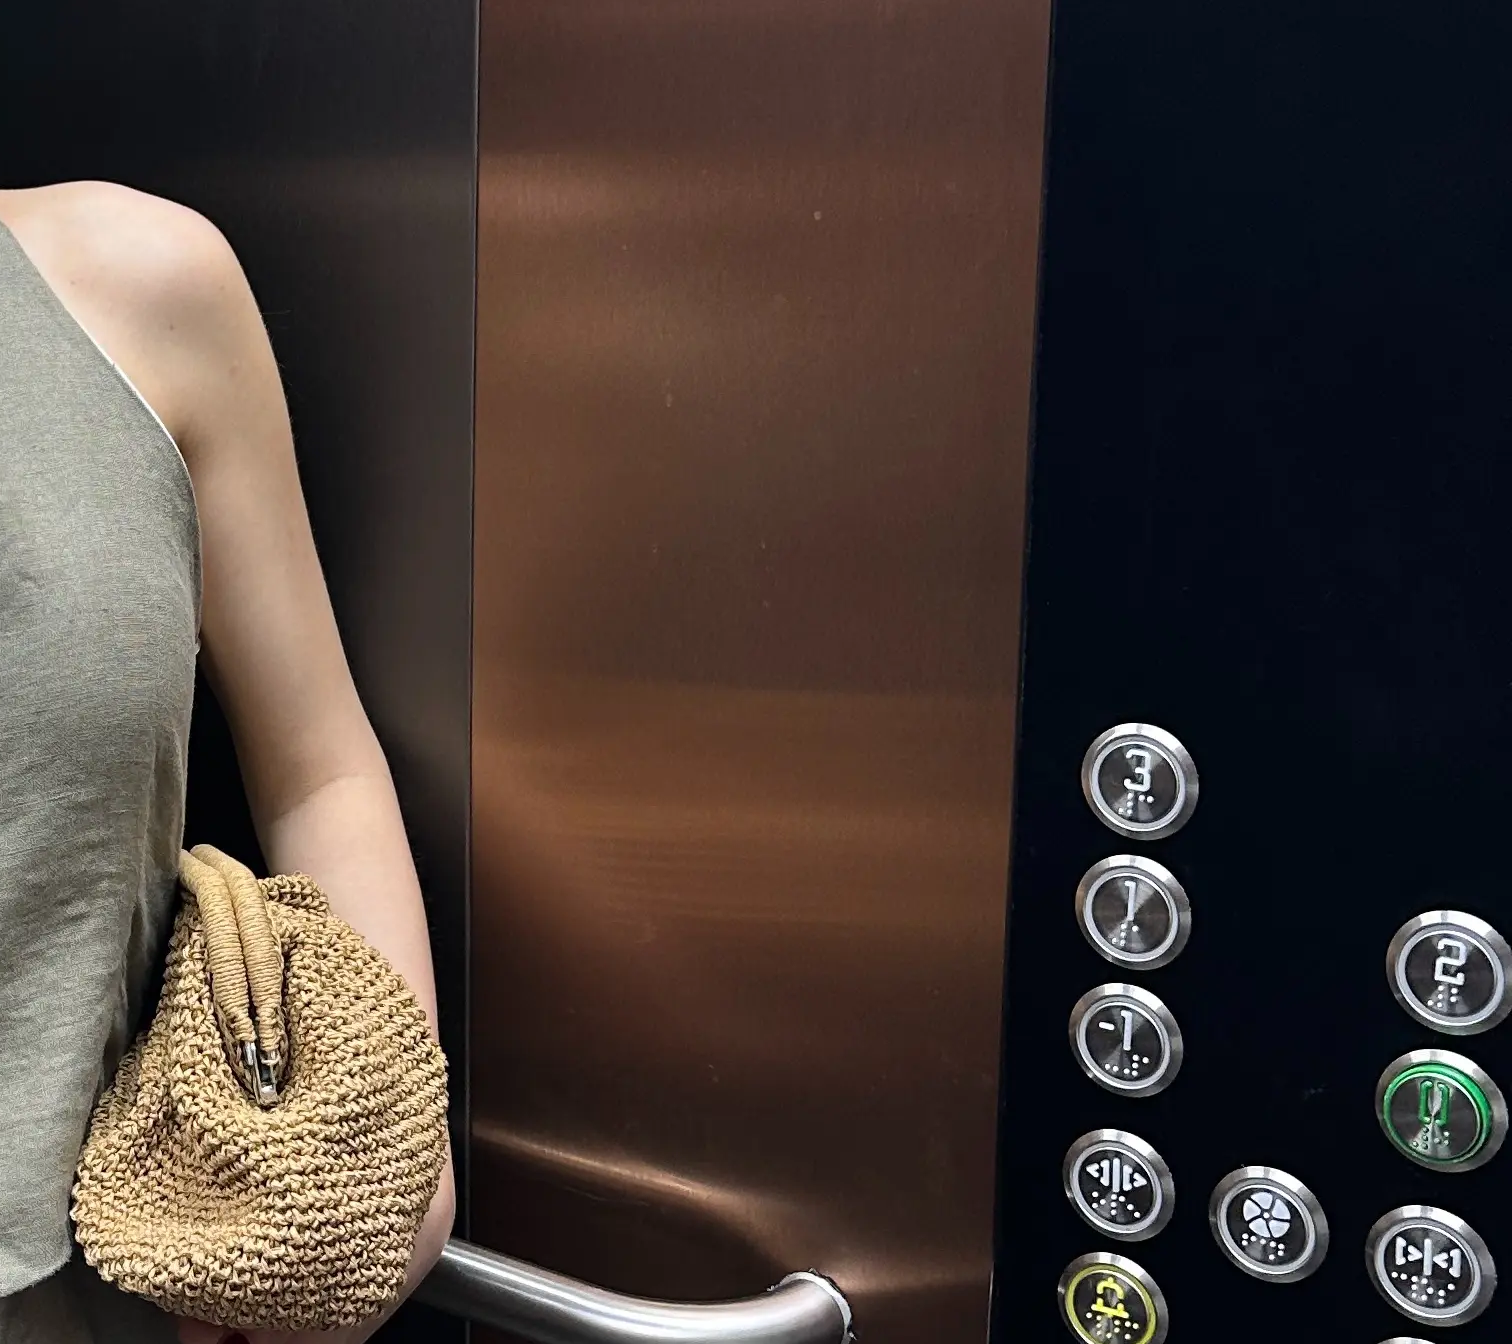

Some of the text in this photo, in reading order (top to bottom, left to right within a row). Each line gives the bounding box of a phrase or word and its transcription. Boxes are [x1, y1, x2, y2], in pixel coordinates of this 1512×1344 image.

[1123, 748, 1152, 792] 3
[1123, 880, 1138, 921] 1
[1434, 937, 1467, 986] 2
[1098, 1009, 1133, 1052] -1
[1417, 1079, 1450, 1126] 0
